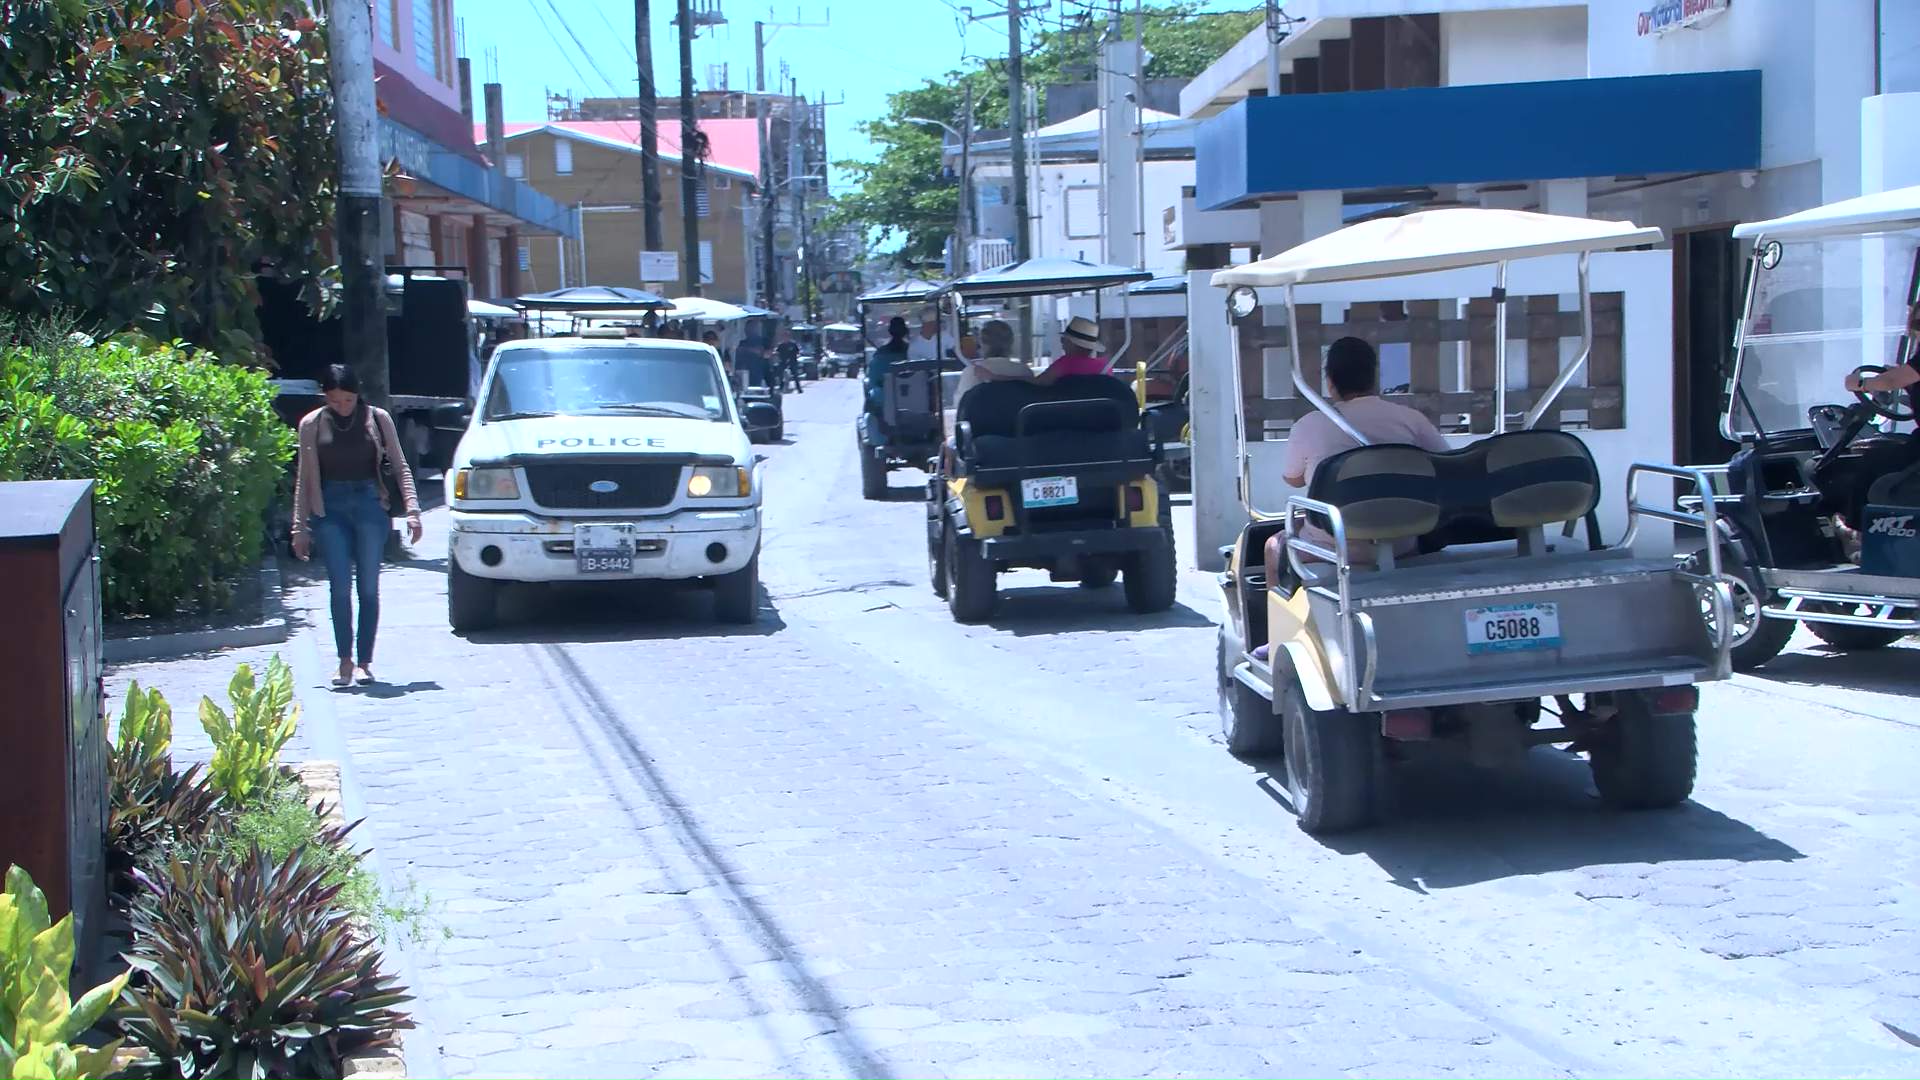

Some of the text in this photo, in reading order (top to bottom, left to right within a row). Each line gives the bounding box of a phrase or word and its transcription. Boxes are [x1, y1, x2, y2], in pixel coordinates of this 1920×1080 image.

[537, 437, 666, 449] POLICE
[1869, 515, 1914, 533] XRT
[587, 558, 631, 570] B-5442
[1485, 617, 1540, 641] C5088
